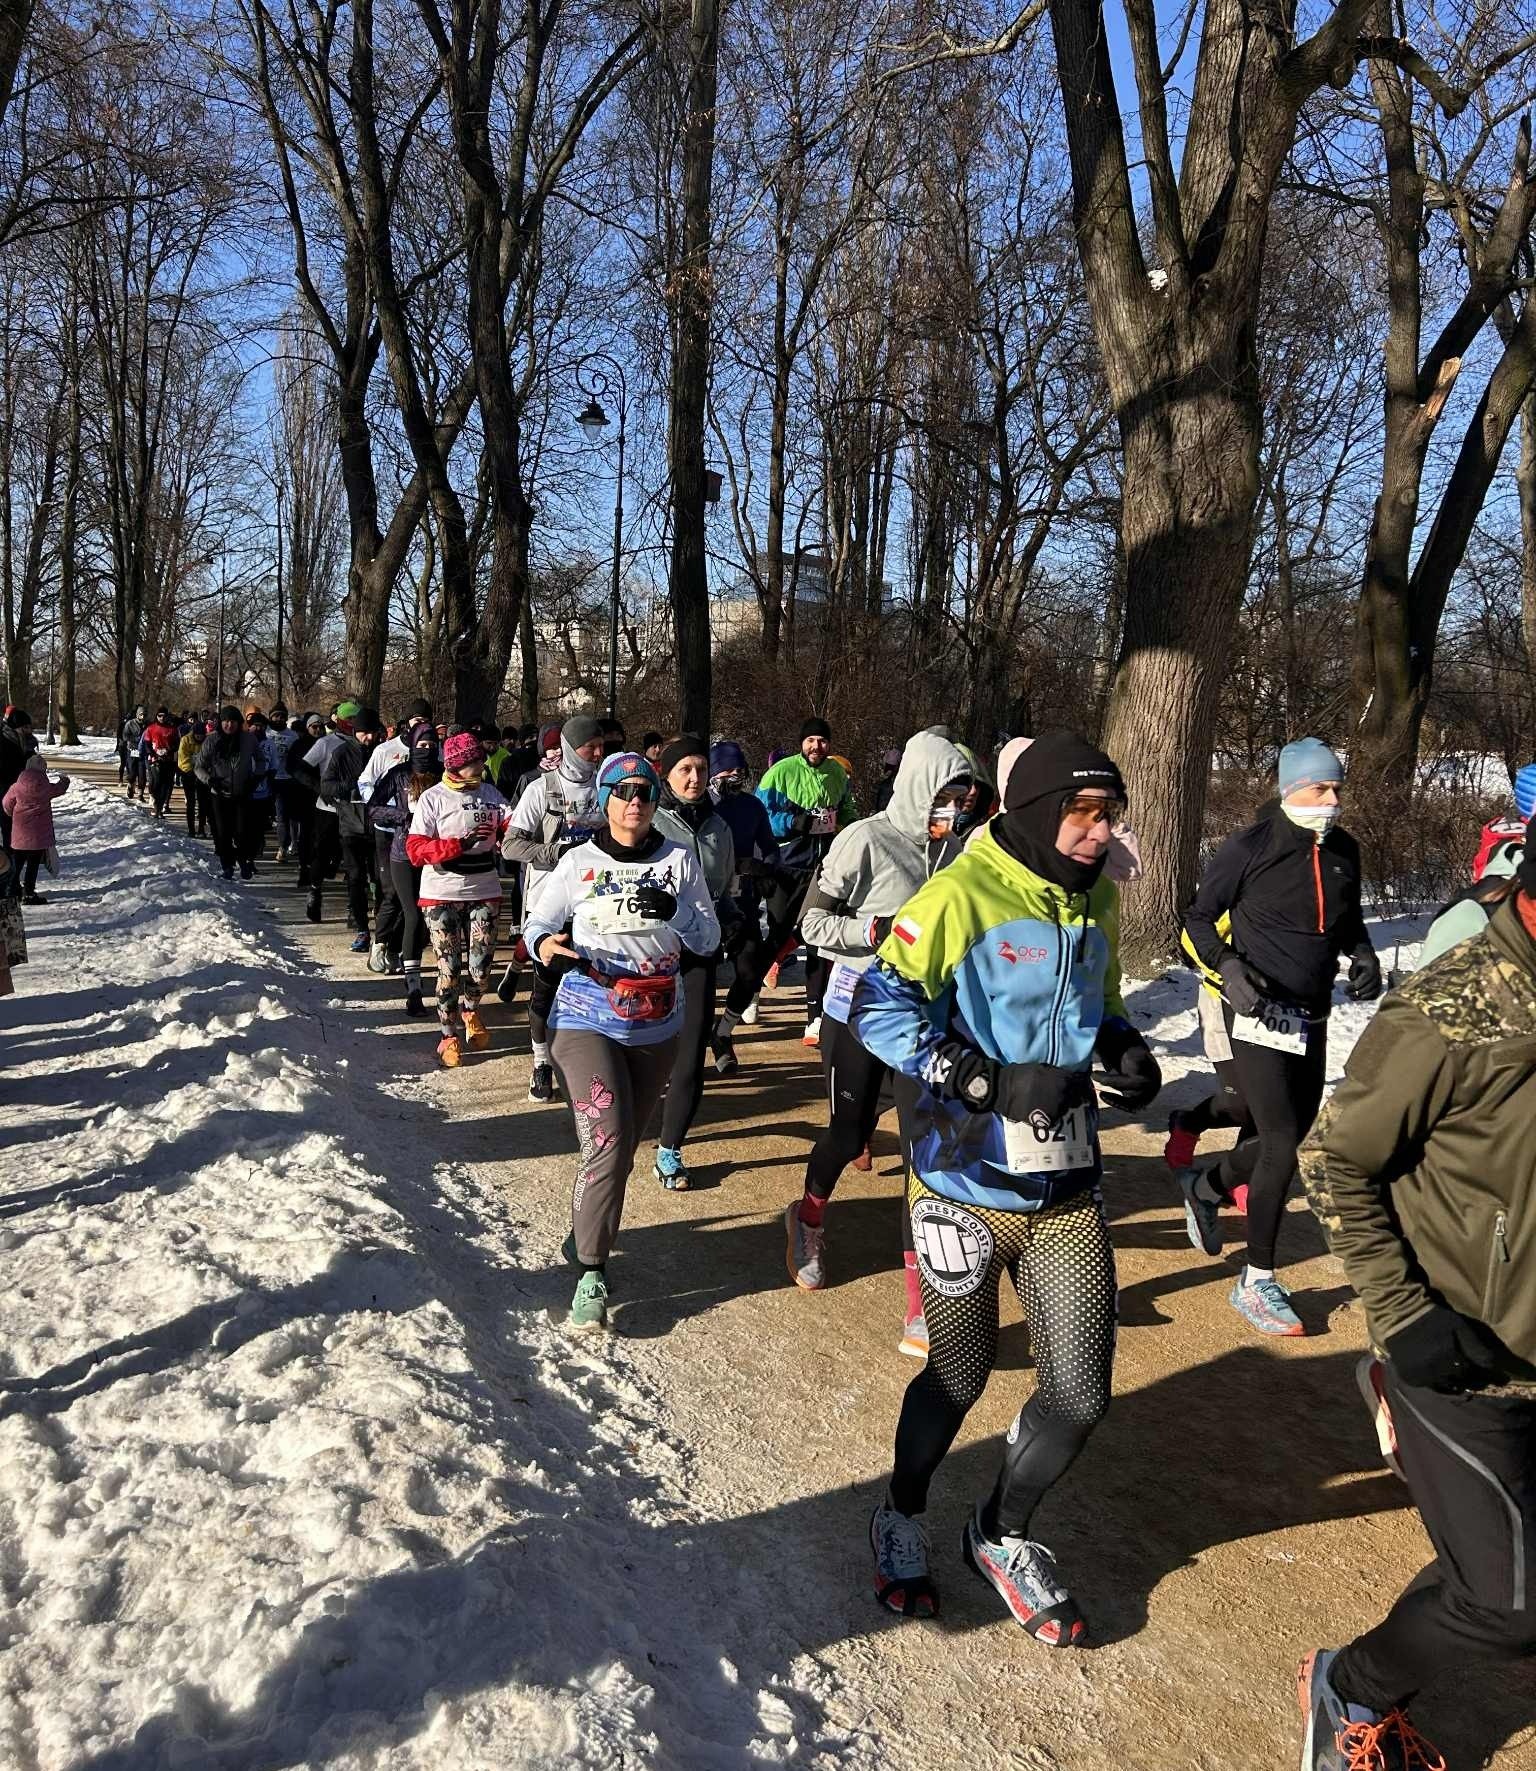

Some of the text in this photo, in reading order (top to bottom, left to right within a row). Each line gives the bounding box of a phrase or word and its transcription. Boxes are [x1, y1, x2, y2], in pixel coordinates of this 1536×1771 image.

[473, 812, 493, 823] 894
[1018, 945, 1048, 960] OCR
[926, 1203, 958, 1217] WEST
[961, 1216, 989, 1247] COAST
[939, 1279, 975, 1294] EIGHTY
[974, 1255, 988, 1279] NINE
